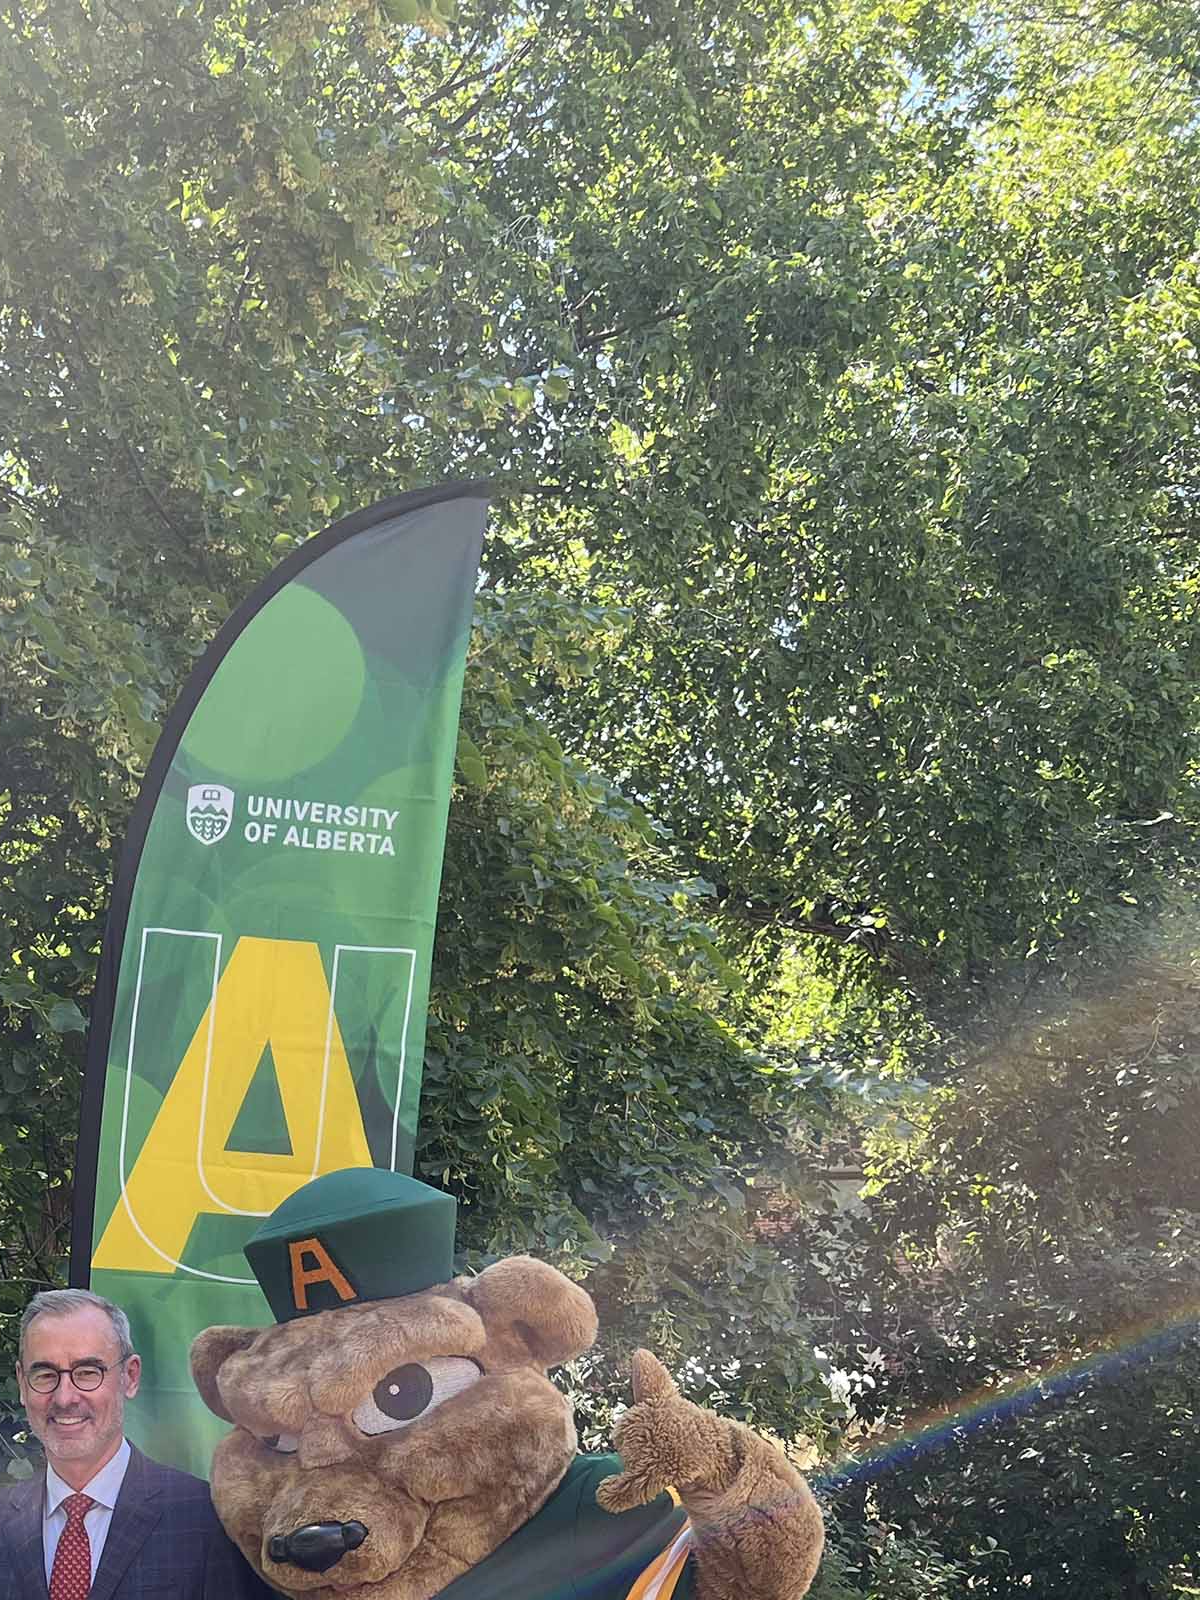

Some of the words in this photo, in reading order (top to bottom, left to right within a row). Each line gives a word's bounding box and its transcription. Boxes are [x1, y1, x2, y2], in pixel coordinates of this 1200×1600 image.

[244, 821, 278, 844] OF
[282, 825, 396, 856] ALBERTA
[246, 795, 400, 830] UNIVERSITY
[90, 936, 374, 1274] A
[288, 1237, 358, 1310] A
